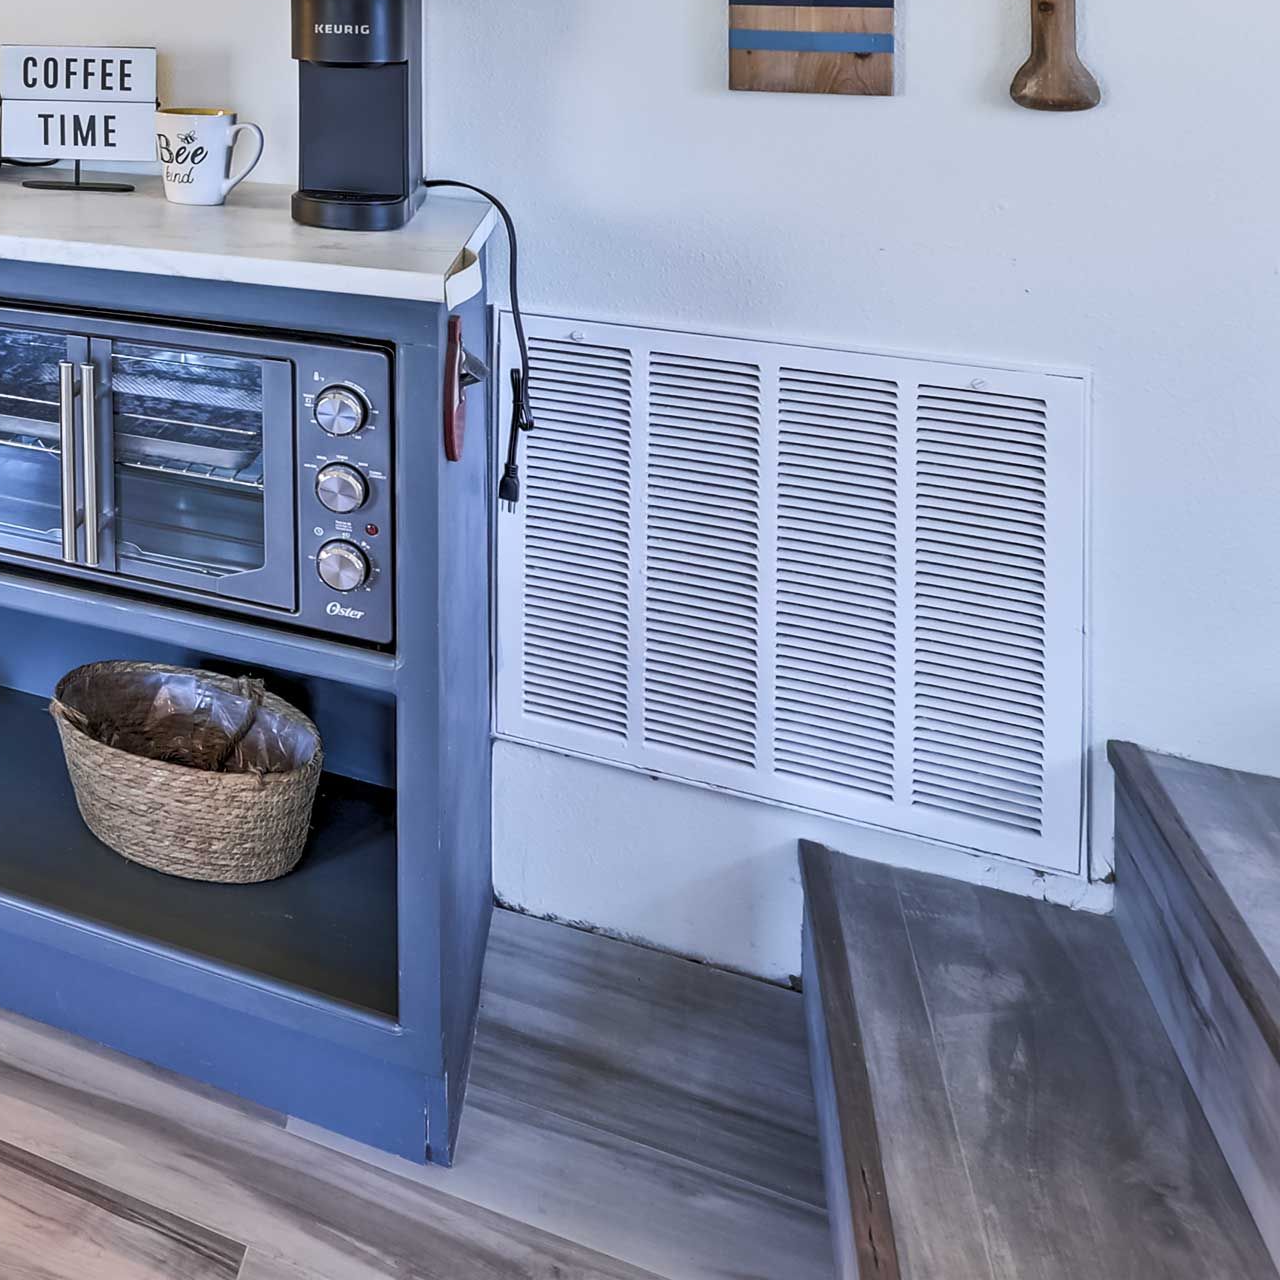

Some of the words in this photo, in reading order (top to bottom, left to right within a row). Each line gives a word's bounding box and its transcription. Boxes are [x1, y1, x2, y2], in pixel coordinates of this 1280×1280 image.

[314, 23, 370, 35] KEURIG
[22, 56, 133, 92] COFFEE
[37, 114, 117, 147] TIME
[155, 133, 208, 165] Bee
[166, 165, 194, 184] kind
[326, 601, 365, 619] Oster
